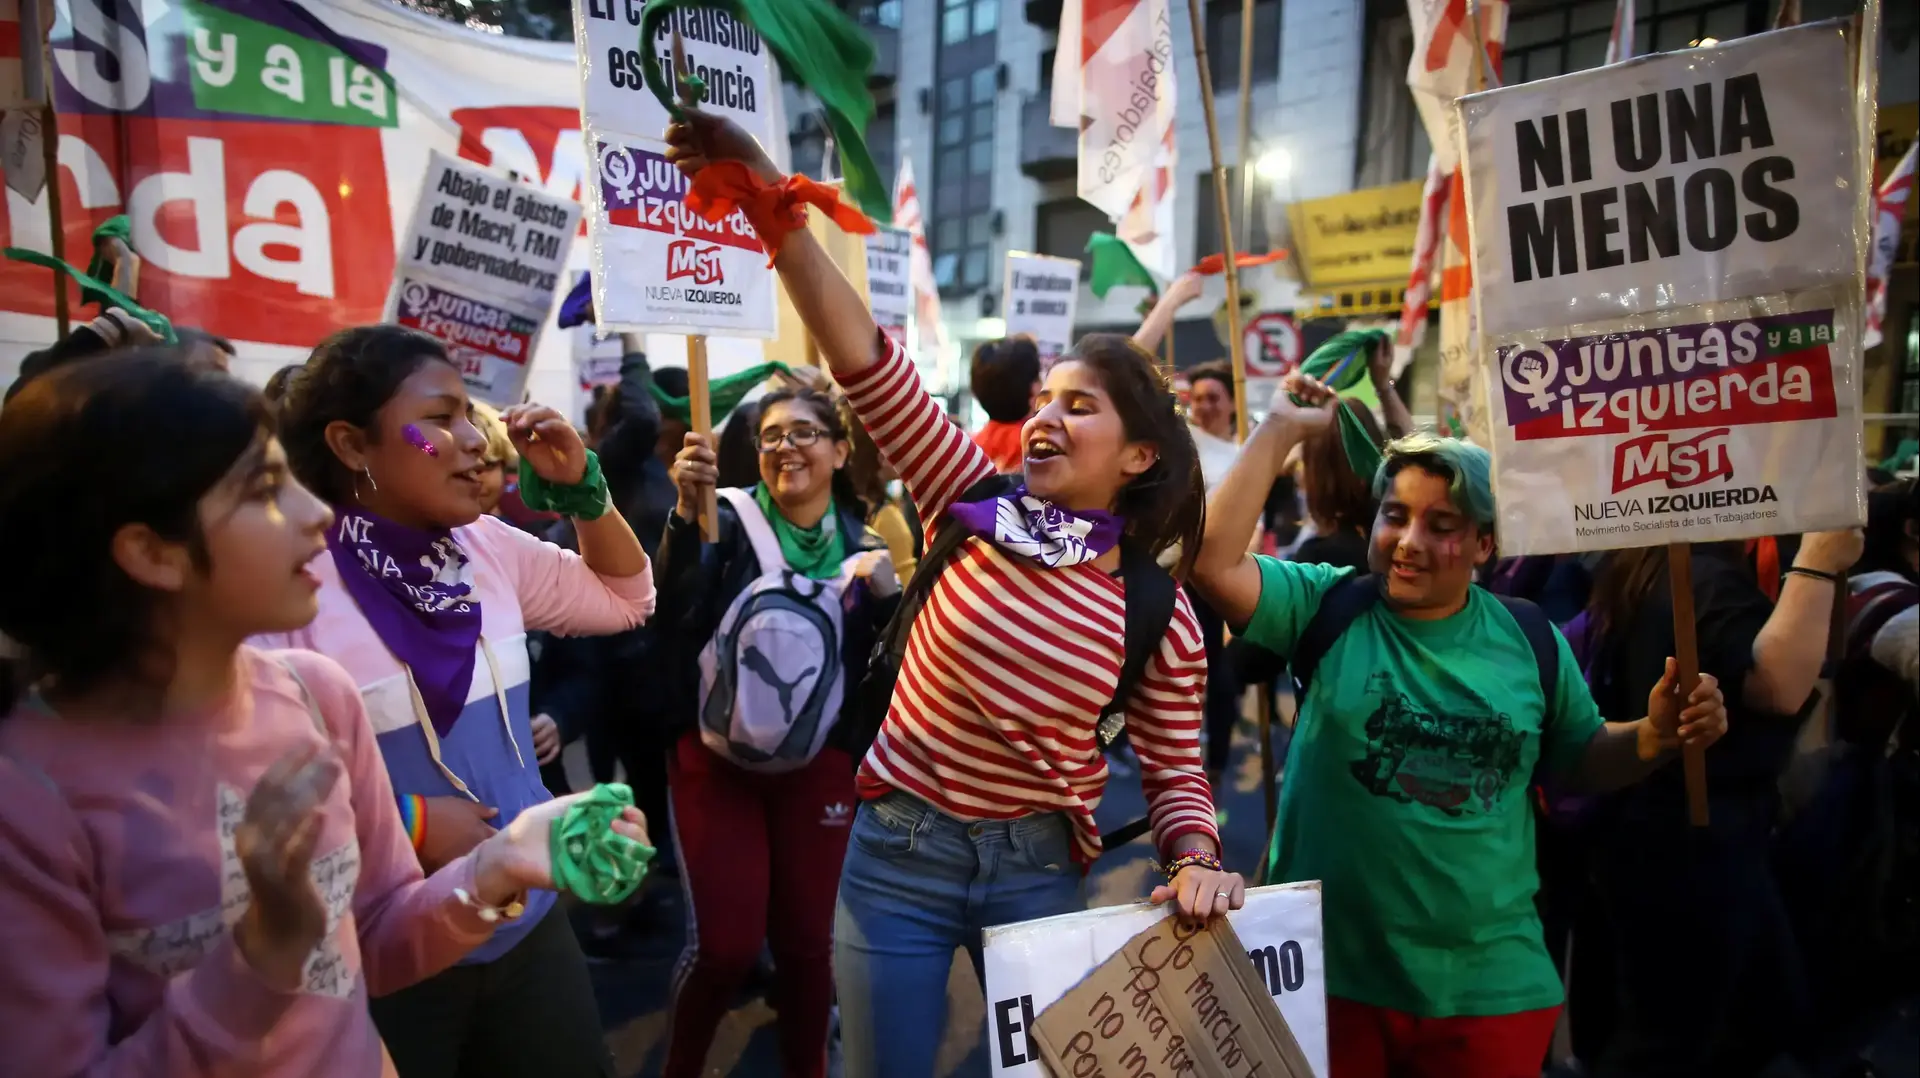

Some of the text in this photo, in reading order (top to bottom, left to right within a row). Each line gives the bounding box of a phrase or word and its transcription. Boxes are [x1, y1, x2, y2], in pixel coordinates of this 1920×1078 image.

[194, 27, 238, 87] y
[260, 43, 304, 103] a
[329, 56, 388, 119] la
[608, 47, 644, 91] es
[1515, 72, 1774, 193] NI UNA
[438, 168, 568, 229] Abajo el ajuste
[1507, 156, 1799, 284] MENOS
[431, 203, 562, 260] de Macri, FMI
[414, 236, 558, 292] y gobernadorxs
[670, 243, 723, 283] MST
[646, 286, 742, 306] NUEVA IZQUIERDA
[1767, 329, 1781, 348] y
[1788, 327, 1802, 344] a
[1809, 323, 1830, 342] la
[1620, 432, 1731, 484] MST
[1575, 485, 1778, 521] NUEVA IZQUIERDA
[1575, 509, 1778, 537] Movimiento Socialista de los Trabajadores
[338, 515, 374, 544] NI
[1087, 991, 1124, 1040] no
